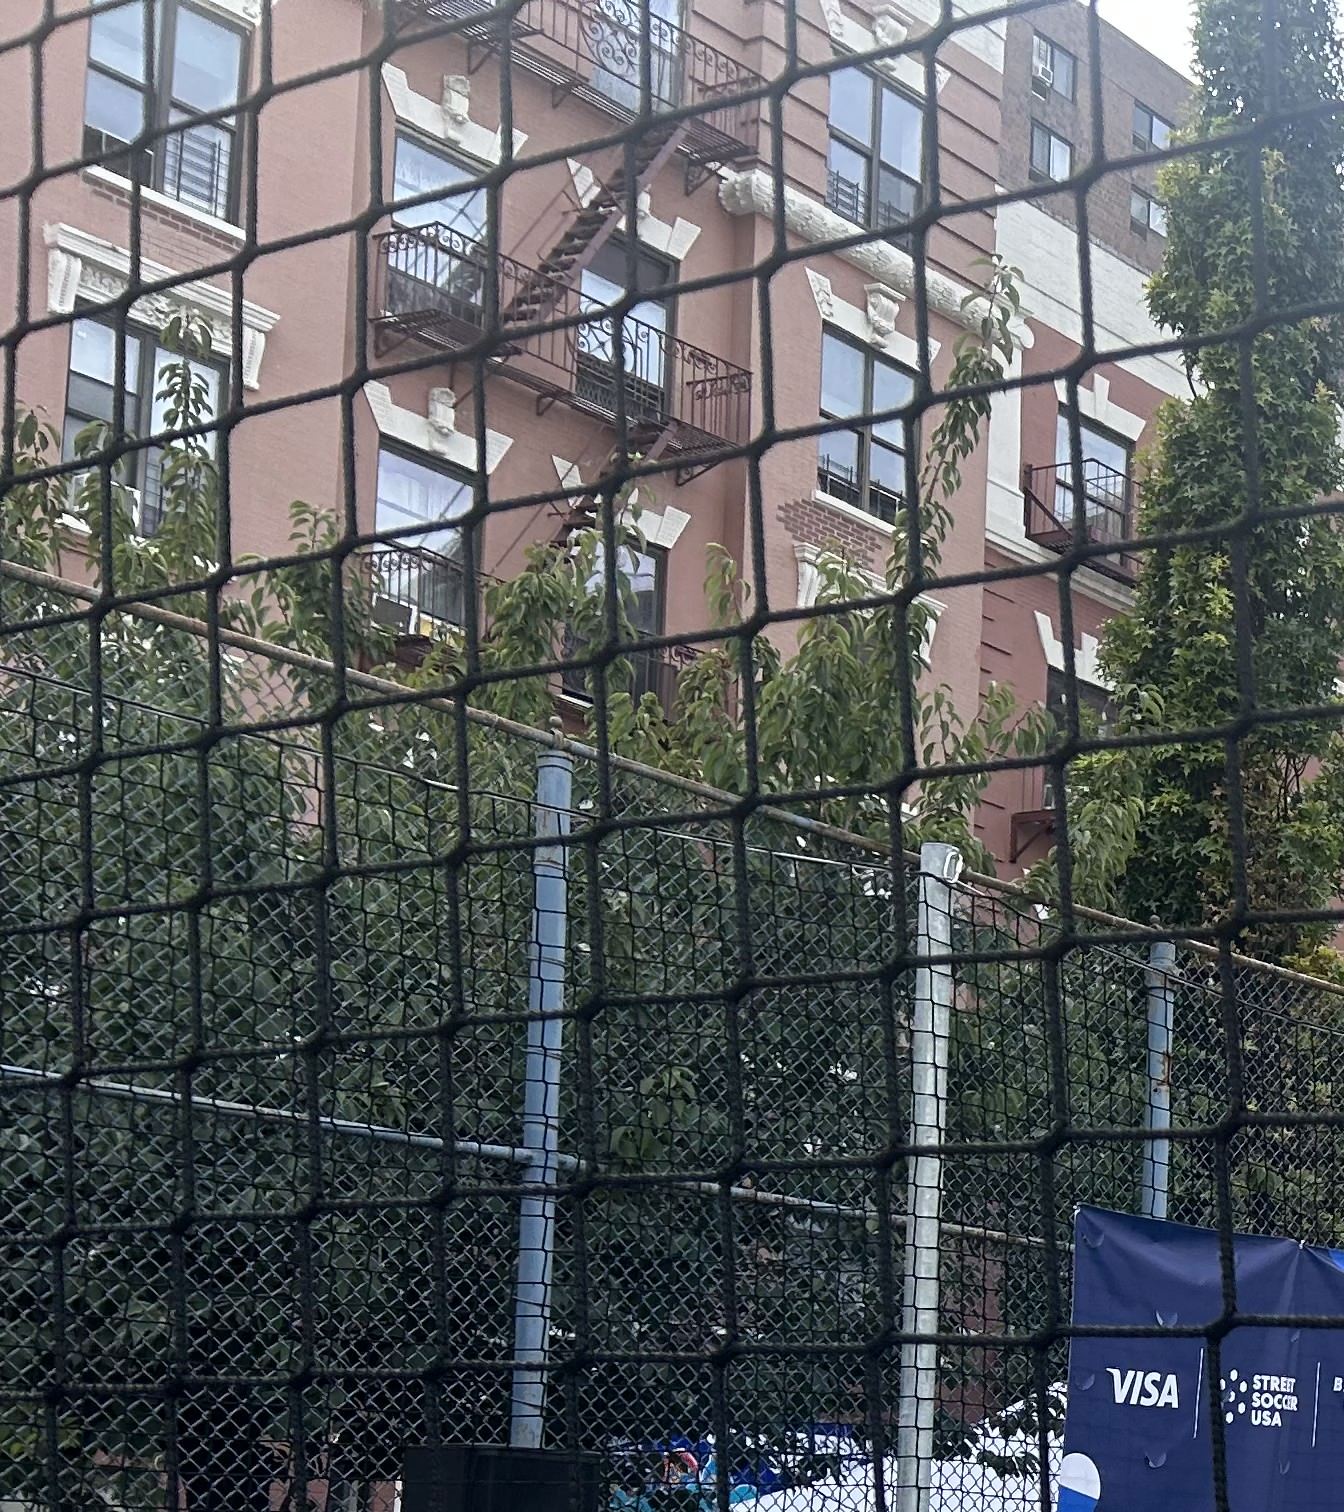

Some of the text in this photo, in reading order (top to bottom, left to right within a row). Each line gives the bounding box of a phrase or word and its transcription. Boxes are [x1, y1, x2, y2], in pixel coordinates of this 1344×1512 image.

[1106, 1367, 1179, 1409] VISA
[1252, 1375, 1296, 1393] STREET
[1251, 1411, 1282, 1427] USA
